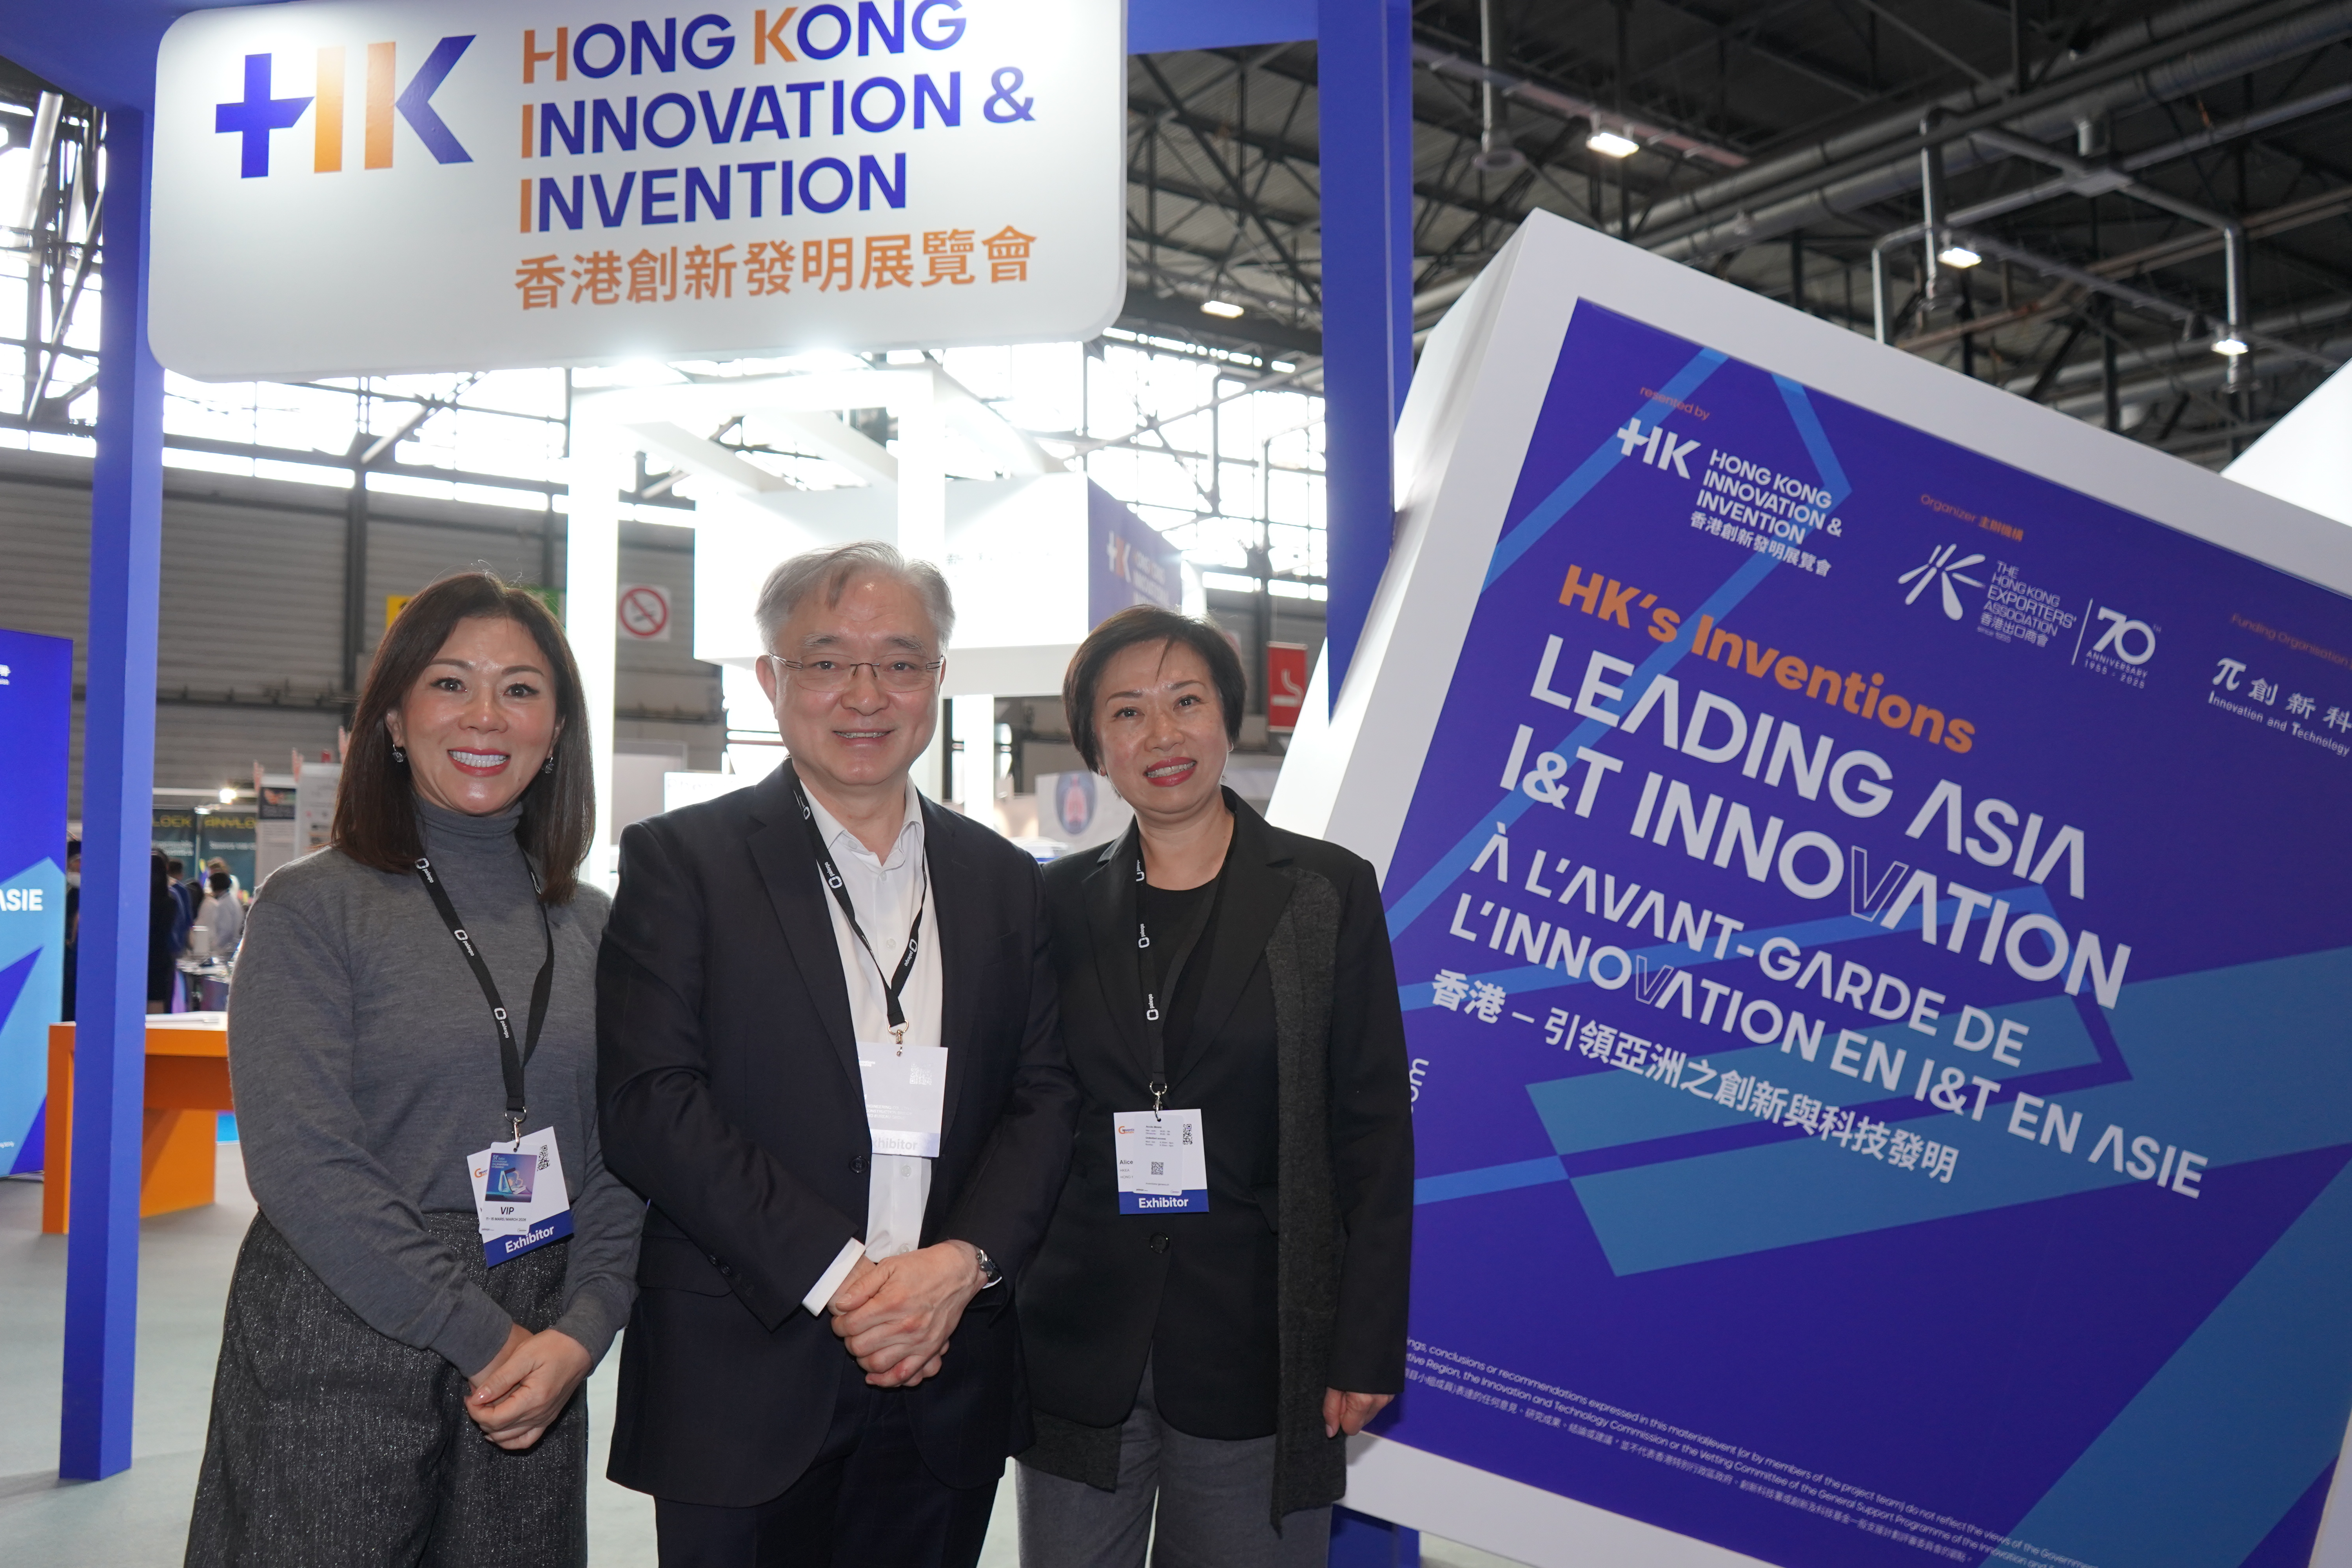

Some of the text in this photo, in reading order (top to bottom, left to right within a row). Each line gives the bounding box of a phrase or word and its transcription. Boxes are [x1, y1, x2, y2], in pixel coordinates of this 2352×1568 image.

[523, 0, 966, 84] HONG KONG
[521, 66, 1036, 159] INNOVATION &
[520, 152, 907, 234] INVENTION
[514, 225, 1037, 311] 香港創新發明展覽會
[1694, 405, 1710, 421] by
[1703, 469, 1842, 537] INNOVATION &
[1710, 449, 1831, 508] HONG KONG
[1696, 489, 1806, 544] INVENTION
[1920, 494, 1976, 522] Organizer
[1691, 511, 1831, 577] 香港創新發明展覽會
[1997, 560, 2019, 579] THE
[1991, 572, 2060, 607] HONG KONG
[1981, 613, 2048, 647] 香港出口商會
[1984, 600, 2058, 637] ASSOCIATION
[2098, 606, 2156, 665] 70
[2231, 613, 2348, 666] Funding Organisation
[1559, 564, 1975, 753] HK's Inventions
[2086, 650, 2147, 678] ANNIVERSARY
[2209, 690, 2350, 757] Innovation and Technology
[1530, 634, 2084, 899] LEADING ASIA
[422, 868, 434, 883] palexpo
[825, 862, 835, 877] palexpo
[1500, 724, 2131, 1009] I&T INNOVATION
[462, 940, 475, 956] palexpo
[904, 949, 914, 967] palexpo
[1470, 821, 2029, 1067] À L'AVANT-GARDE DE
[500, 1020, 509, 1038] palexpo
[1449, 893, 2208, 1199] L'INNOVATION EN I&T EN ASIE
[1432, 969, 1506, 1024] 香港
[1544, 1007, 1959, 1183] 引領亞洲之創新與科技發明
[500, 1207, 514, 1215] VIP
[1138, 1197, 1189, 1208] Exhibitor
[505, 1226, 555, 1253] Exhibitor
[1406, 1353, 1426, 1365] tive
